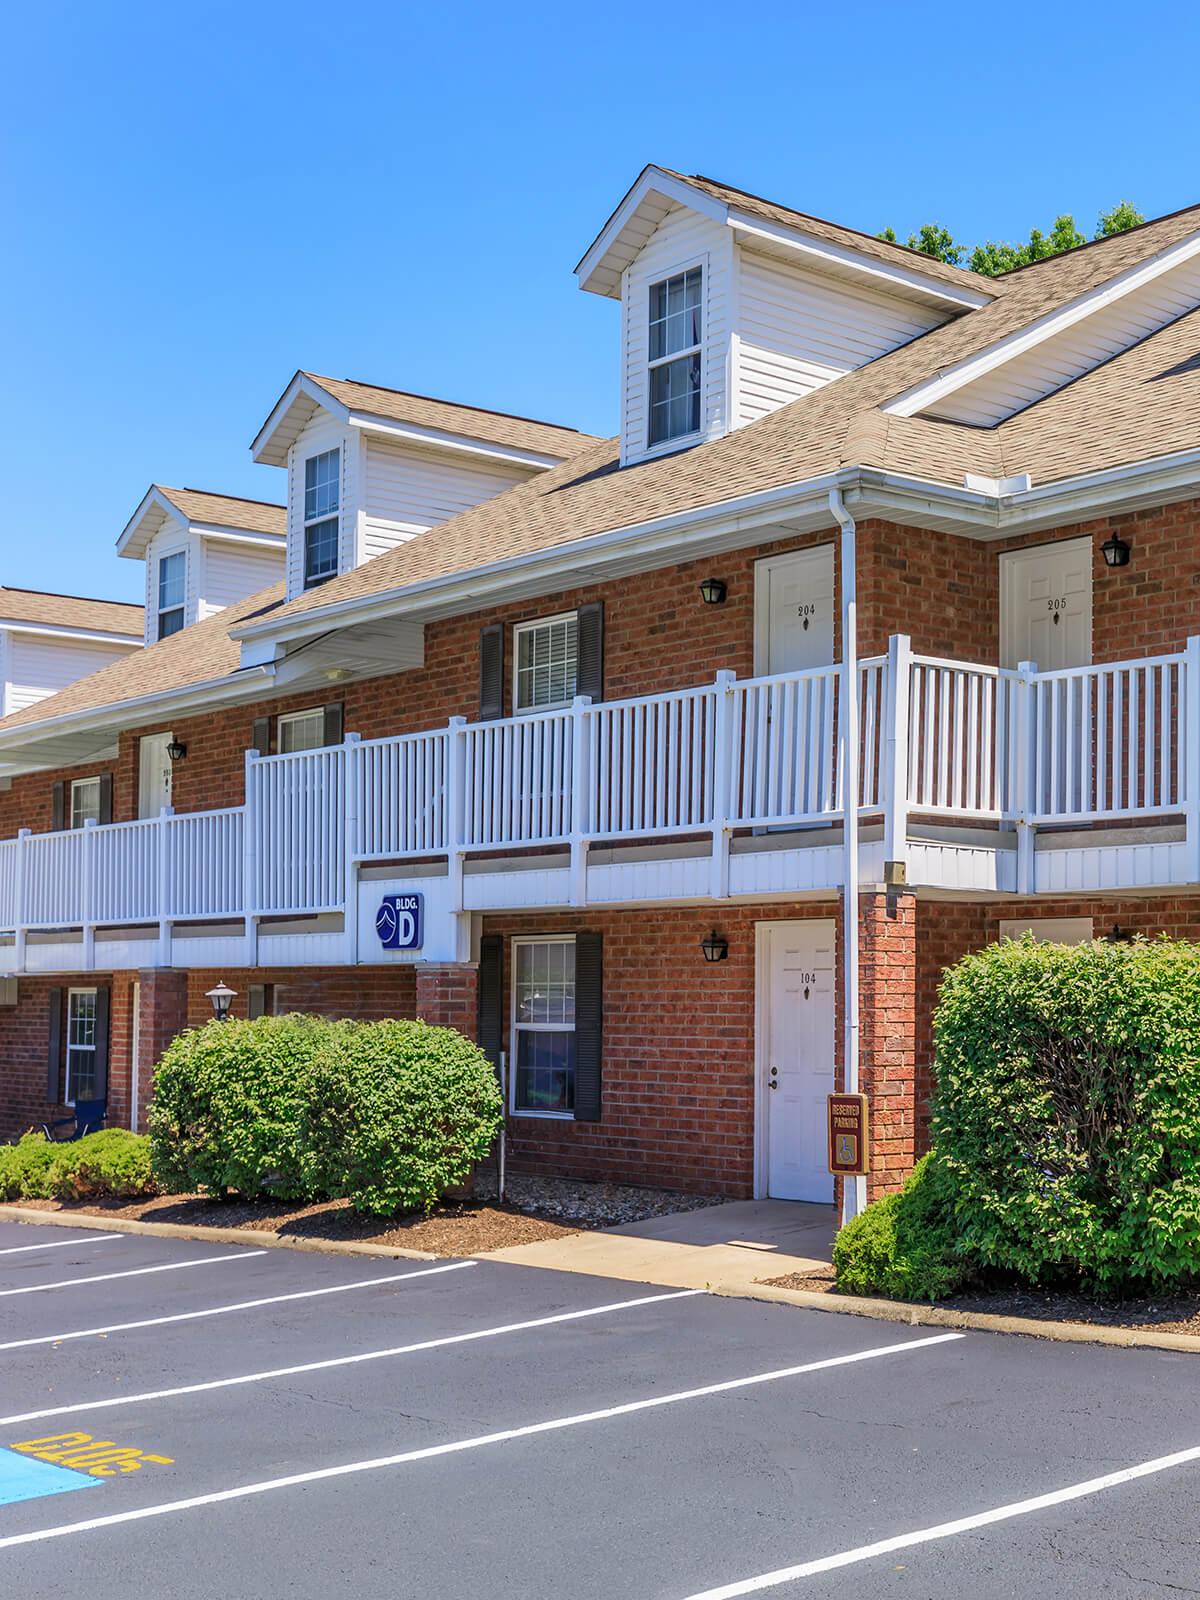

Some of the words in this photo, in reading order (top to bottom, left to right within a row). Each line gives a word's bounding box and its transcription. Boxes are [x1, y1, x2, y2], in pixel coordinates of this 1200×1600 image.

[1047, 597, 1067, 610] 205
[798, 604, 815, 616] 204
[395, 898, 418, 910] BLDG.
[399, 911, 415, 946] D
[801, 972, 816, 984] 104
[832, 1104, 860, 1116] RESERVED
[834, 1116, 859, 1129] PARKING
